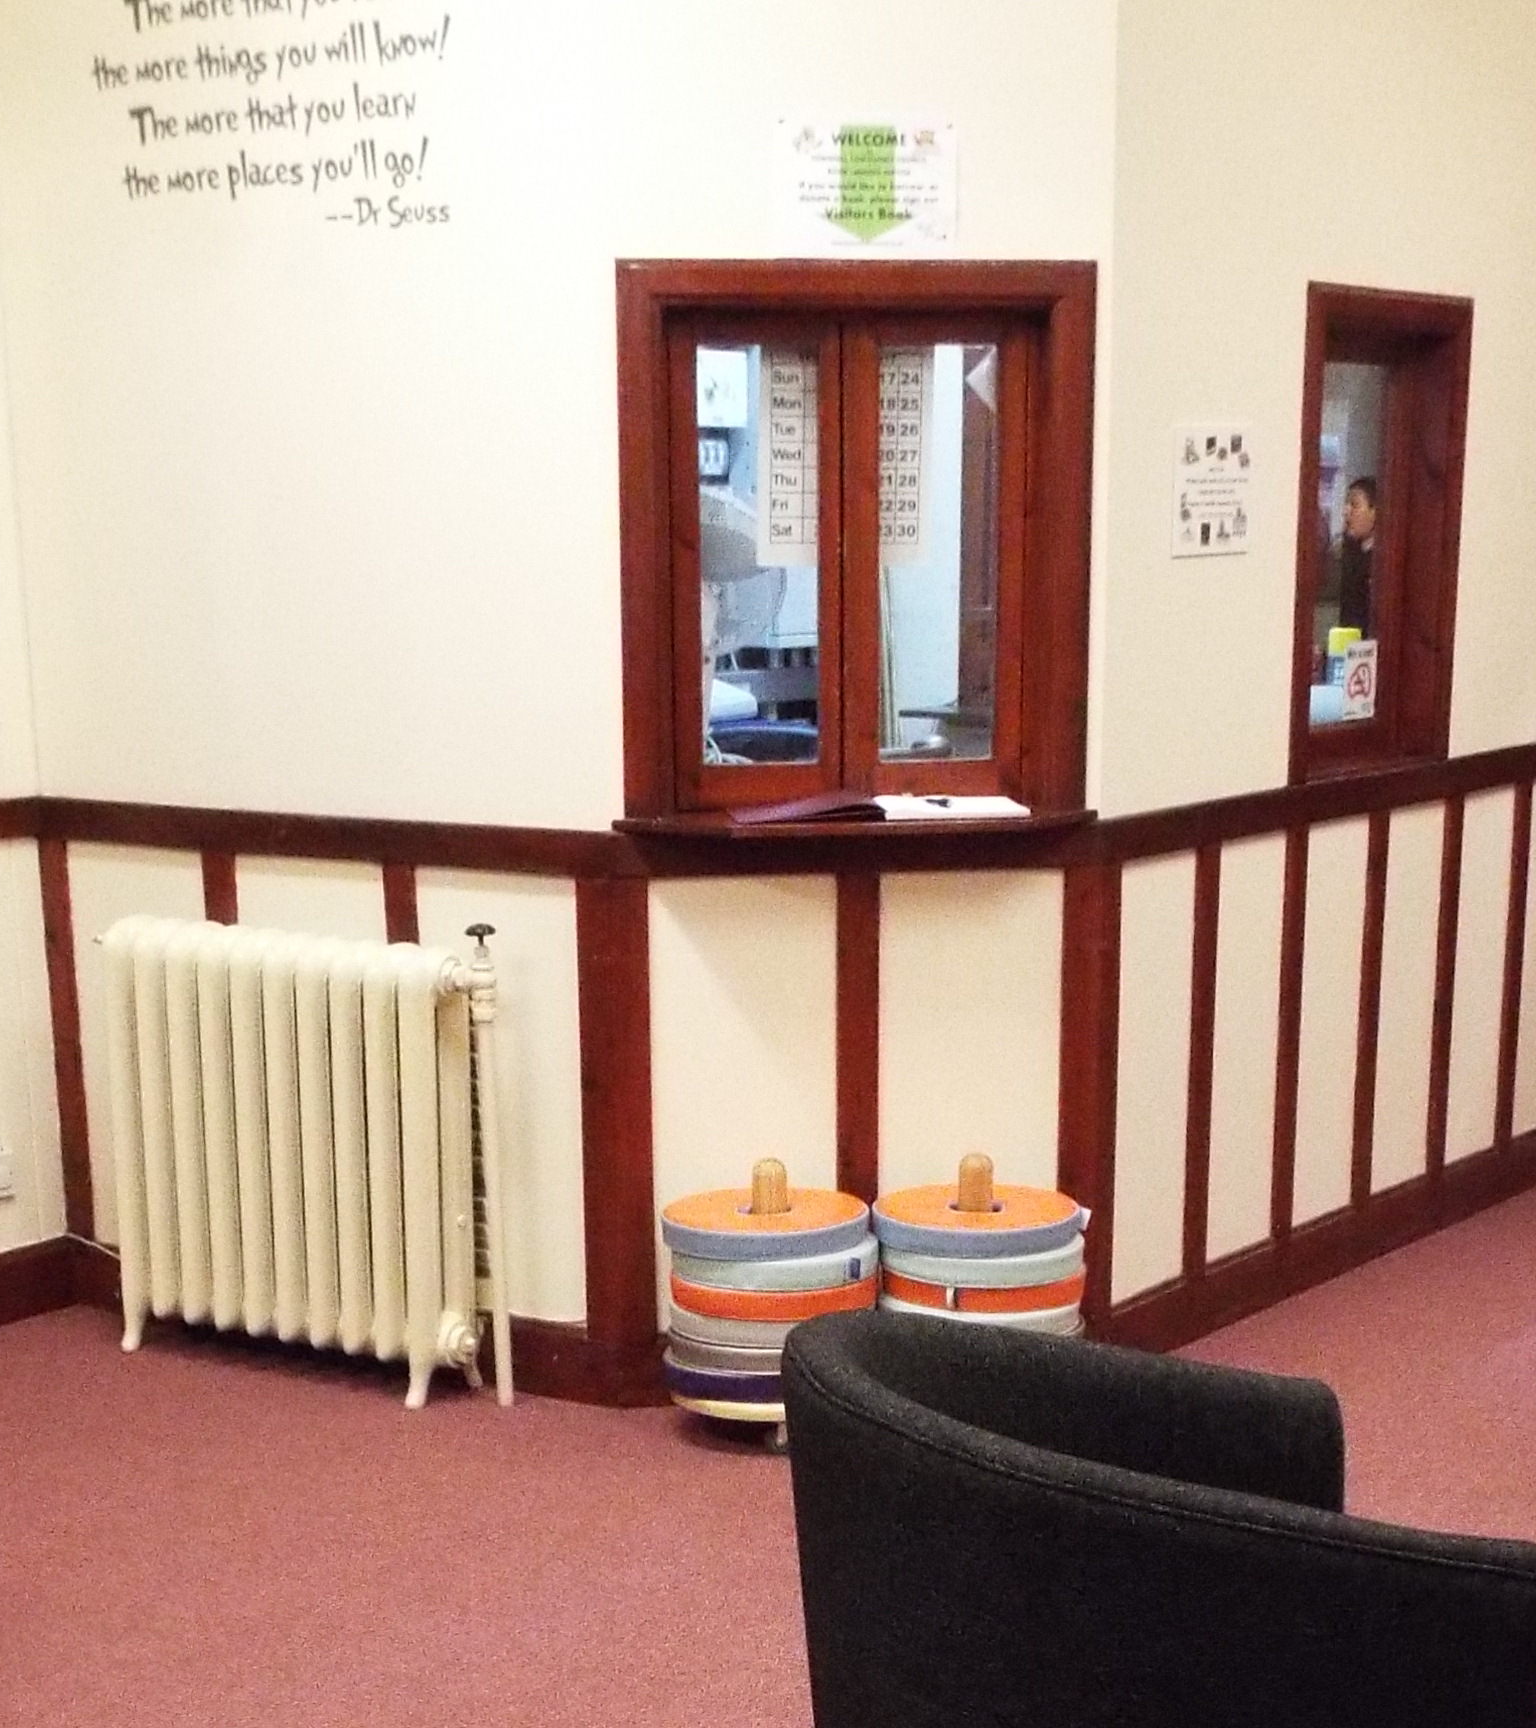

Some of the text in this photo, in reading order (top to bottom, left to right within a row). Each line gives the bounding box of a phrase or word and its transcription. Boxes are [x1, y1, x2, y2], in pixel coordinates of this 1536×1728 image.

[93, 13, 450, 91] the more things you will know!
[128, 82, 416, 146] The more that you learn
[123, 135, 429, 201] the more places you'll go!
[387, 195, 450, 228] Seuss
[772, 368, 799, 384] Sun
[901, 371, 920, 385] 24
[772, 396, 802, 410] Mon
[901, 398, 919, 411] 25
[773, 423, 796, 436] Tue
[900, 424, 919, 437] 26
[772, 449, 801, 461] Wed
[899, 450, 918, 462] 27
[773, 474, 797, 487] Thu
[898, 474, 917, 487] 28
[772, 499, 789, 511] Fri
[897, 499, 916, 512] 29
[772, 525, 793, 537] Sat
[897, 525, 915, 538] 30
